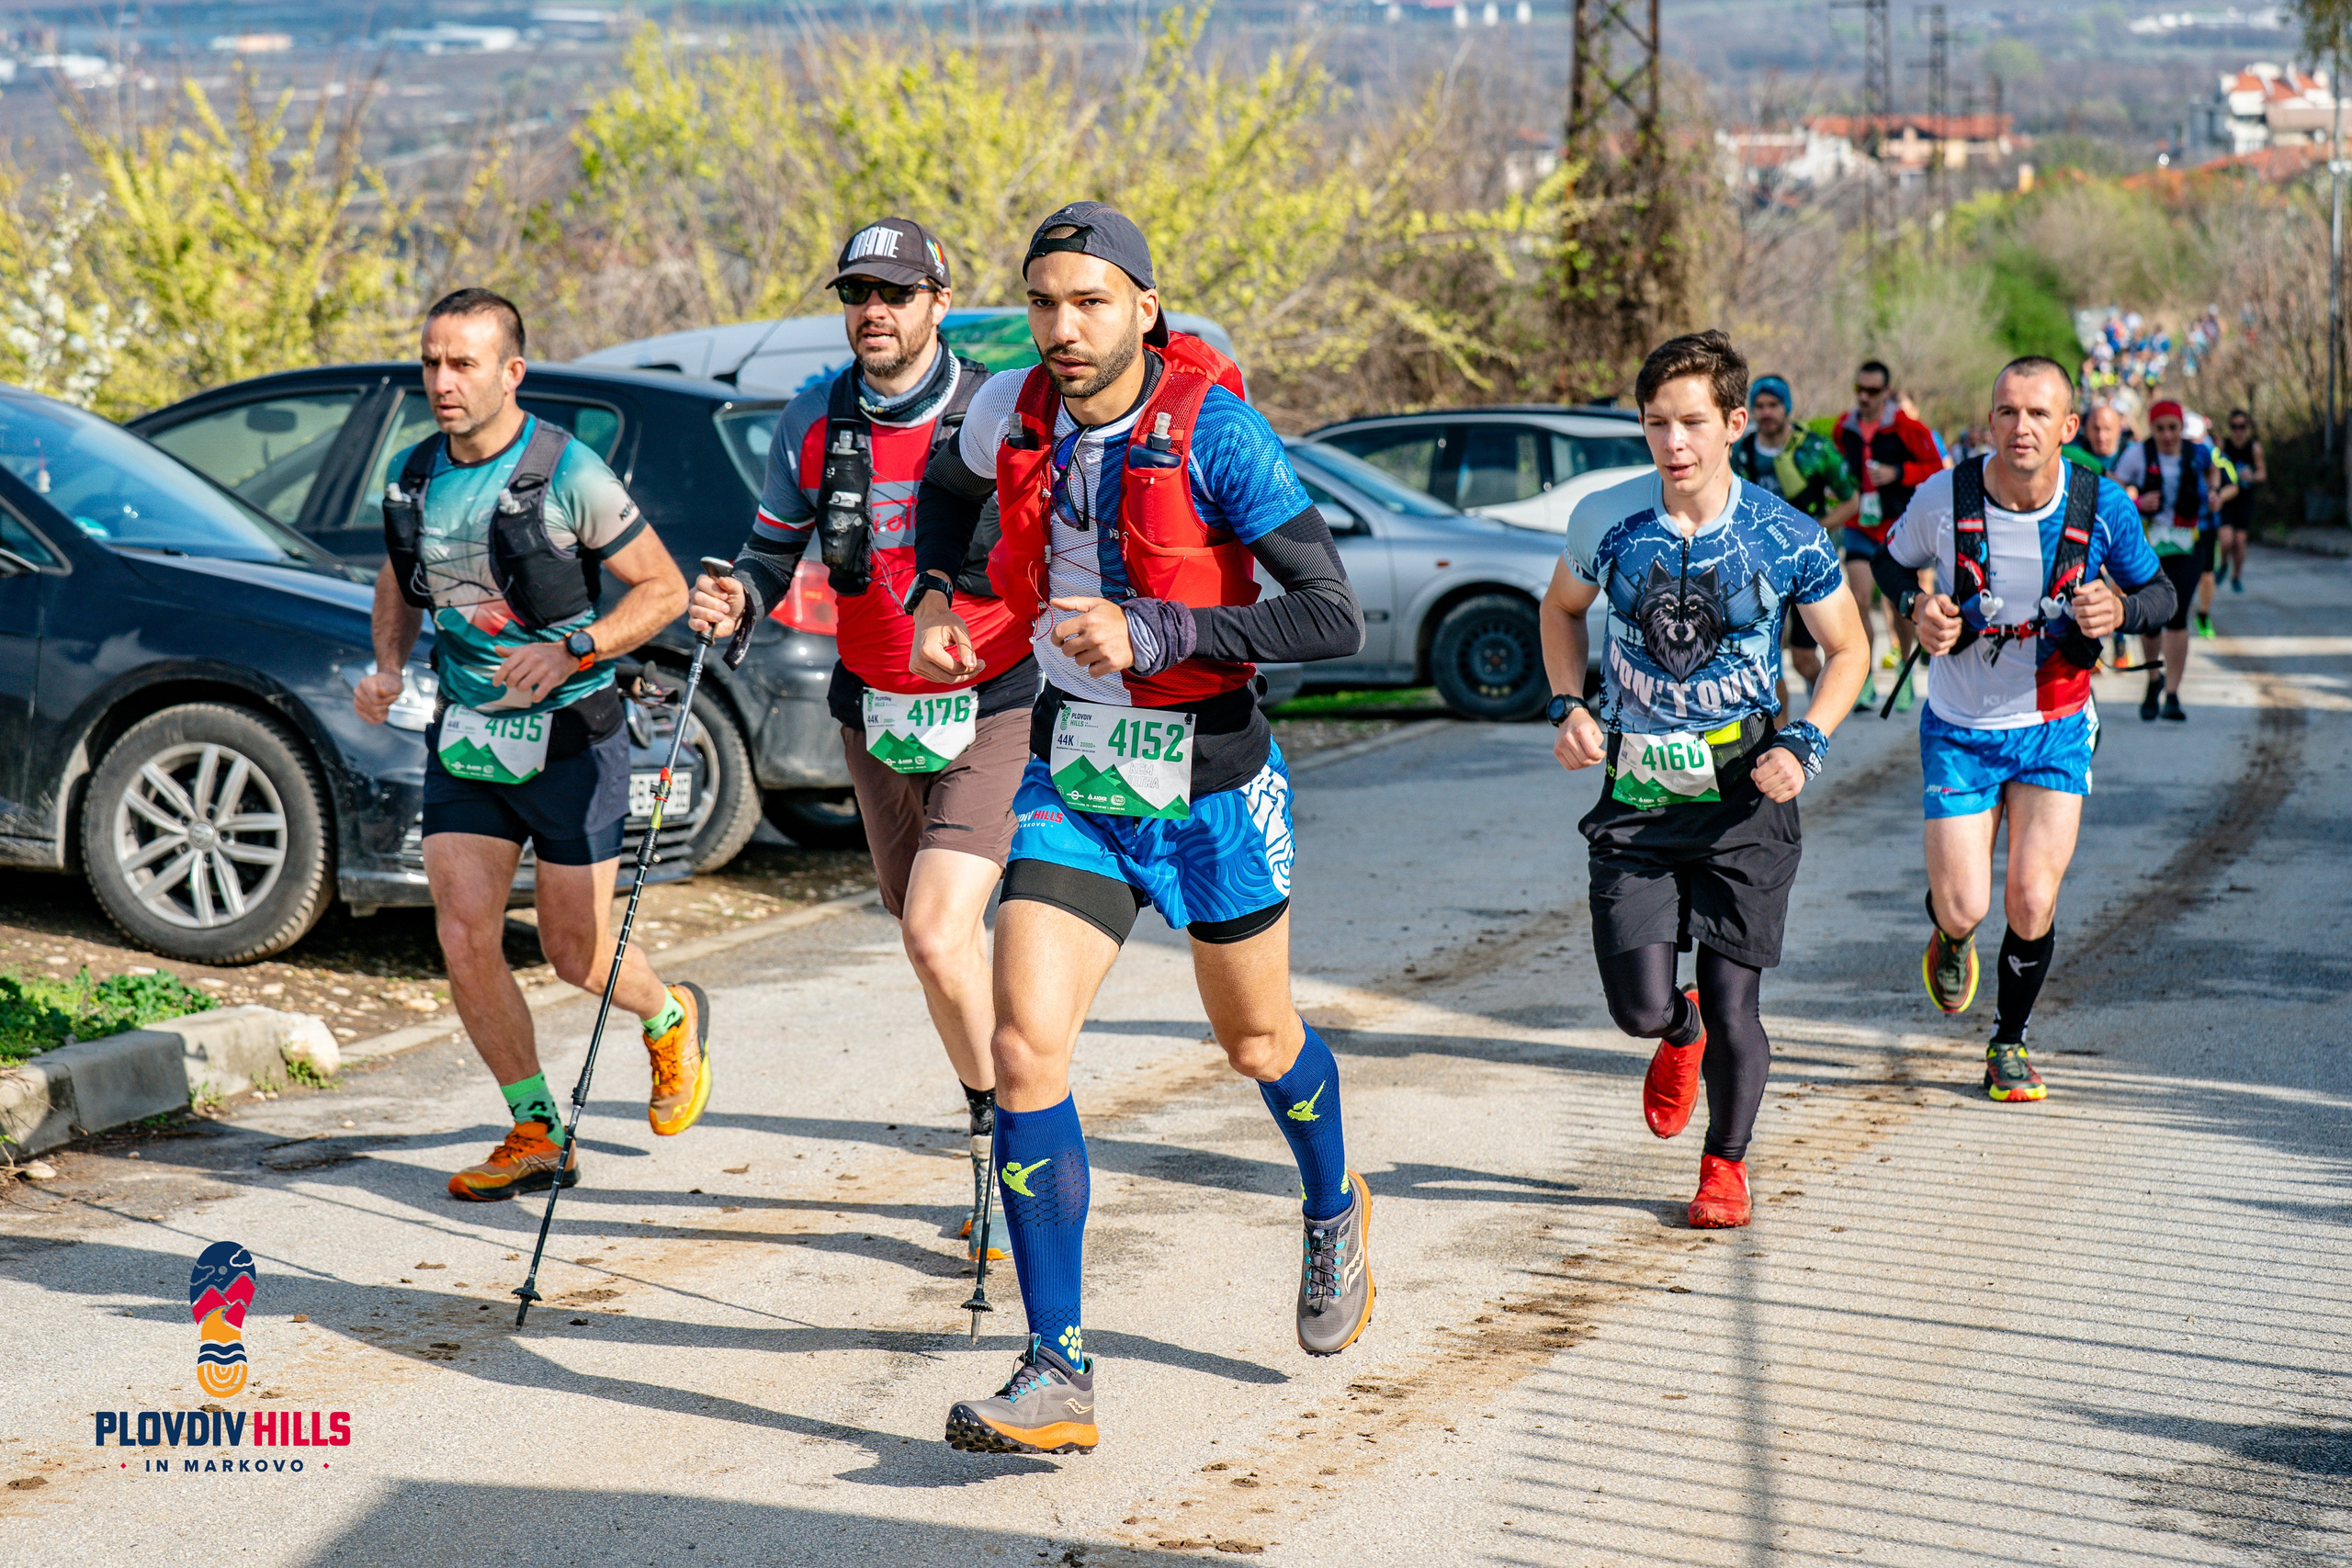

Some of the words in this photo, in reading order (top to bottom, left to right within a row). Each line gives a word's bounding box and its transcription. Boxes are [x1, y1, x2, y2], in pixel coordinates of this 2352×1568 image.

[1610, 640, 1690, 718] DON'T
[1697, 657, 1770, 712] QUIT
[907, 695, 971, 727] 4176
[484, 715, 544, 742] 4195
[1057, 734, 1074, 746] 44K
[1107, 718, 1185, 763] 4152
[1129, 762, 1155, 775] KCM
[1642, 740, 1705, 771] 4160
[1127, 774, 1159, 789] ULTRA
[1033, 810, 1064, 824] HILLS
